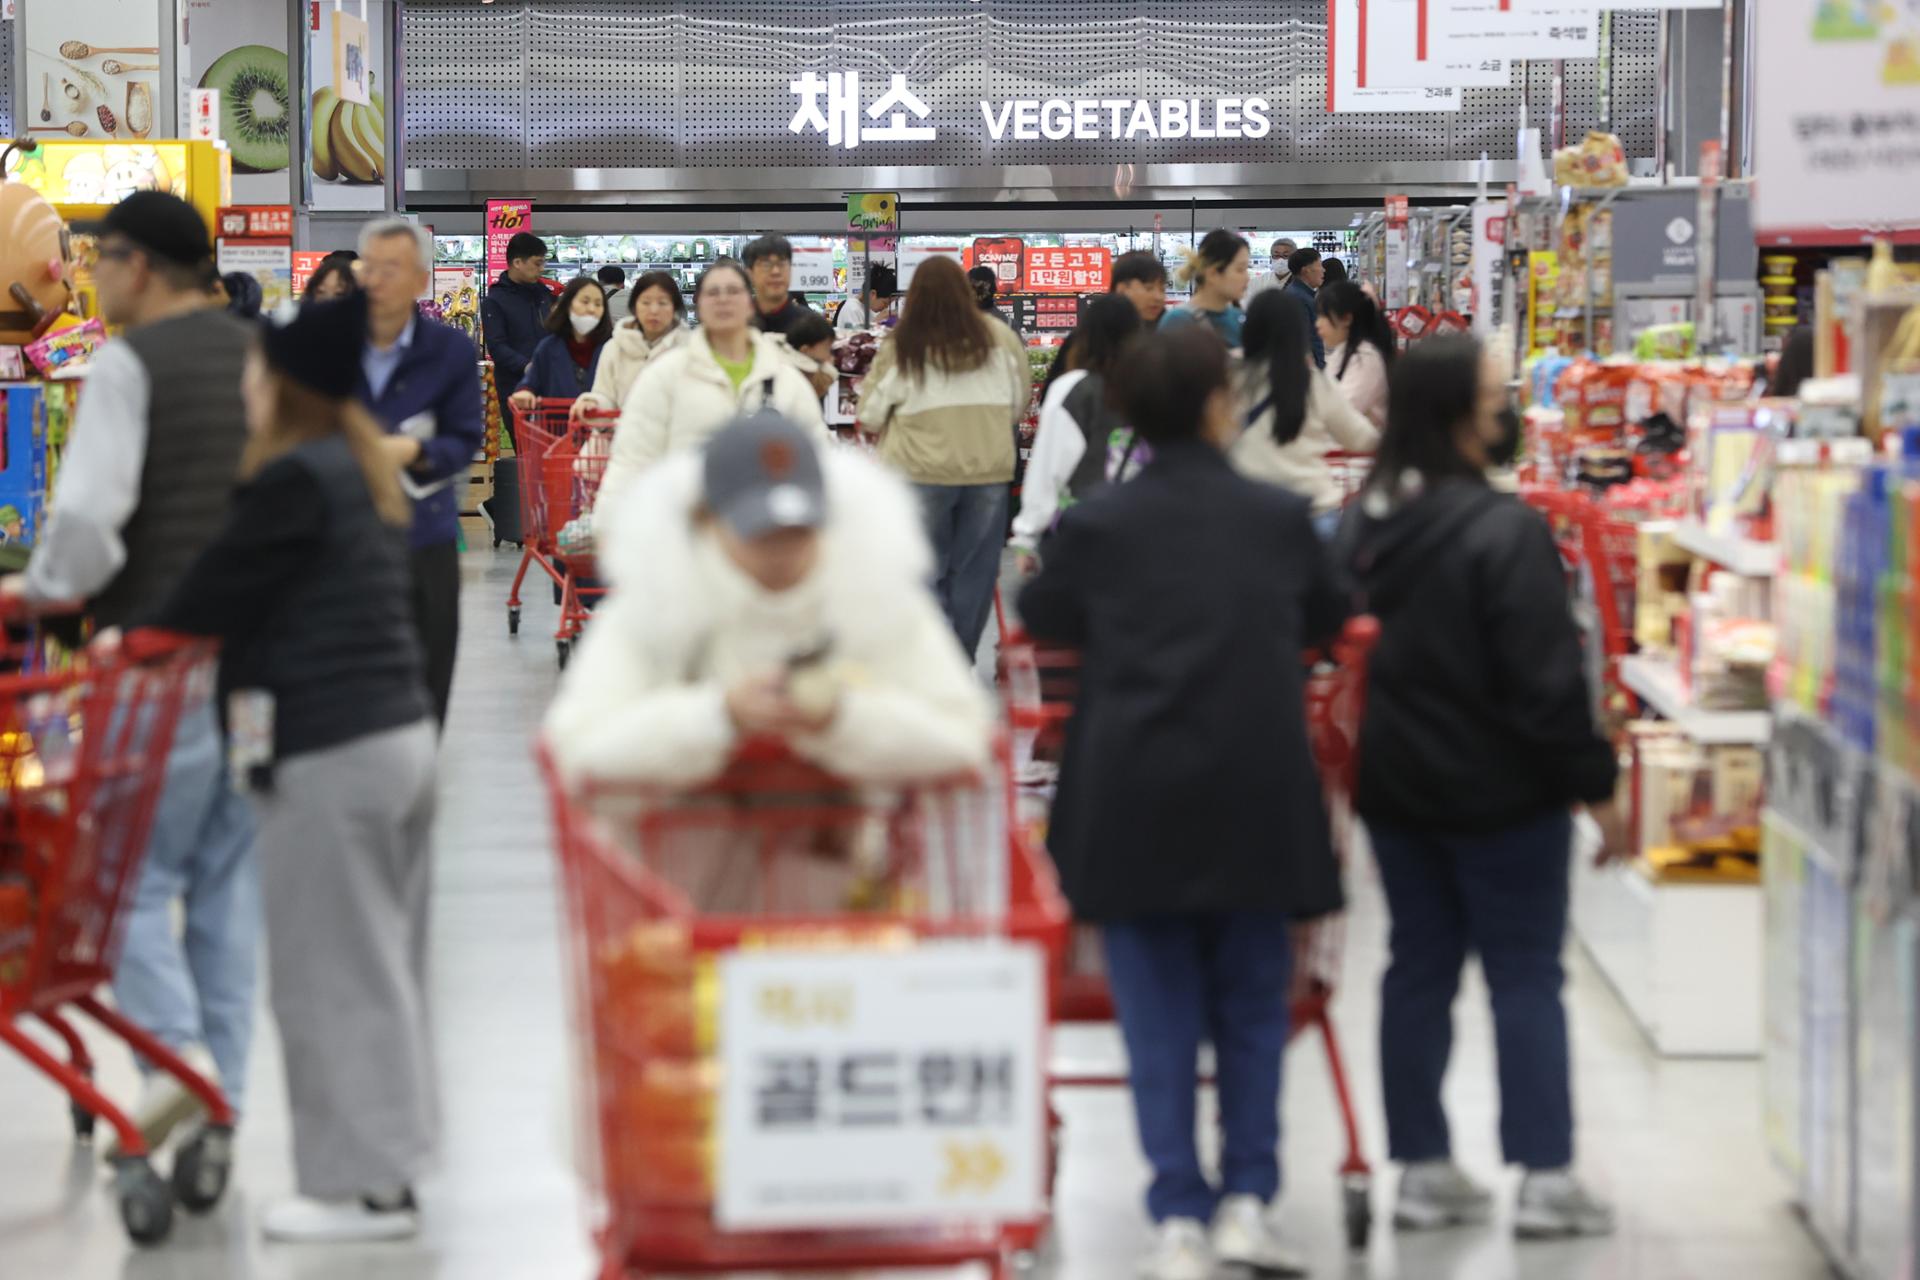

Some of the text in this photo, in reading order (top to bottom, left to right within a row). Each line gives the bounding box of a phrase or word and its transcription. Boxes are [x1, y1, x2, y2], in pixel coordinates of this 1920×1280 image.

[1480, 59, 1502, 72] 소금
[788, 71, 936, 148] 채소
[980, 98, 1271, 140] VEGETABLES
[490, 212, 530, 229] HOT
[850, 214, 893, 232] Spring
[1030, 252, 1103, 268] 모든고객
[800, 275, 829, 287] 9,990
